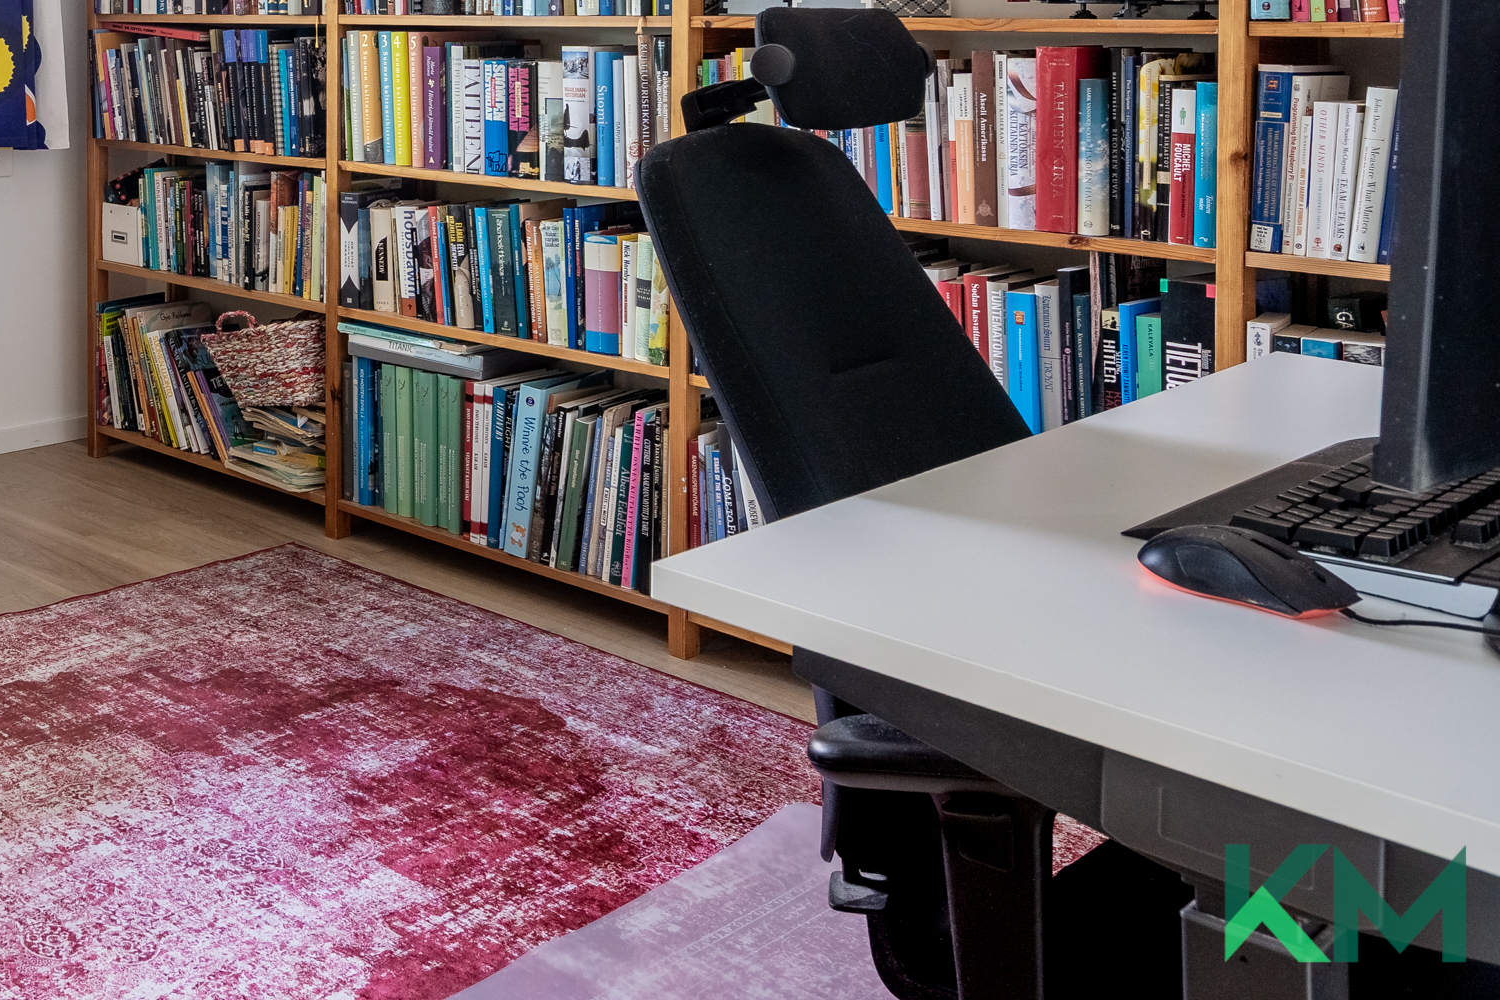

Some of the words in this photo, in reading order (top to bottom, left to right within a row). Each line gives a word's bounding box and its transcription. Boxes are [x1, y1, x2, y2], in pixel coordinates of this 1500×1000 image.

[350, 34, 354, 46] 1
[362, 34, 368, 46] 2
[382, 35, 387, 47] 3
[394, 36, 400, 48] 4
[411, 36, 416, 49] 5
[493, 64, 506, 122] SUOMEN
[597, 85, 607, 124] Suomi
[465, 60, 480, 168] TAITEEN
[1053, 82, 1068, 149] TÄHTIEN
[1319, 110, 1327, 140] OTHER
[980, 117, 988, 161] Amerikassa
[1010, 110, 1018, 153] KULTAINEN
[1009, 155, 1018, 177] KIRJA
[1173, 143, 1182, 181] FOUCAULT
[1182, 144, 1191, 172] MICHEL
[1318, 144, 1326, 173] MINDS
[1368, 147, 1379, 179] Measure
[1051, 155, 1064, 197] KIRJA
[1340, 178, 1348, 200] TEAM
[1340, 202, 1345, 210] OF
[1365, 181, 1376, 202] What
[1337, 211, 1346, 238] TEAMS
[1361, 205, 1373, 235] Matters
[1042, 295, 1051, 327] Katariina
[152, 336, 172, 368] SUOMEN
[389, 341, 414, 353] TITANIC
[1043, 329, 1052, 351] Suuri
[1103, 340, 1116, 383] HITLER
[159, 369, 173, 398] LUONTO
[1044, 361, 1052, 392] TROYAT
[522, 417, 535, 454] Winnie
[520, 460, 532, 480] the
[620, 467, 630, 498] Albert
[515, 486, 527, 511] Pooh
[748, 500, 758, 525] NOUSEVA
[616, 500, 627, 536] Edelfelt
